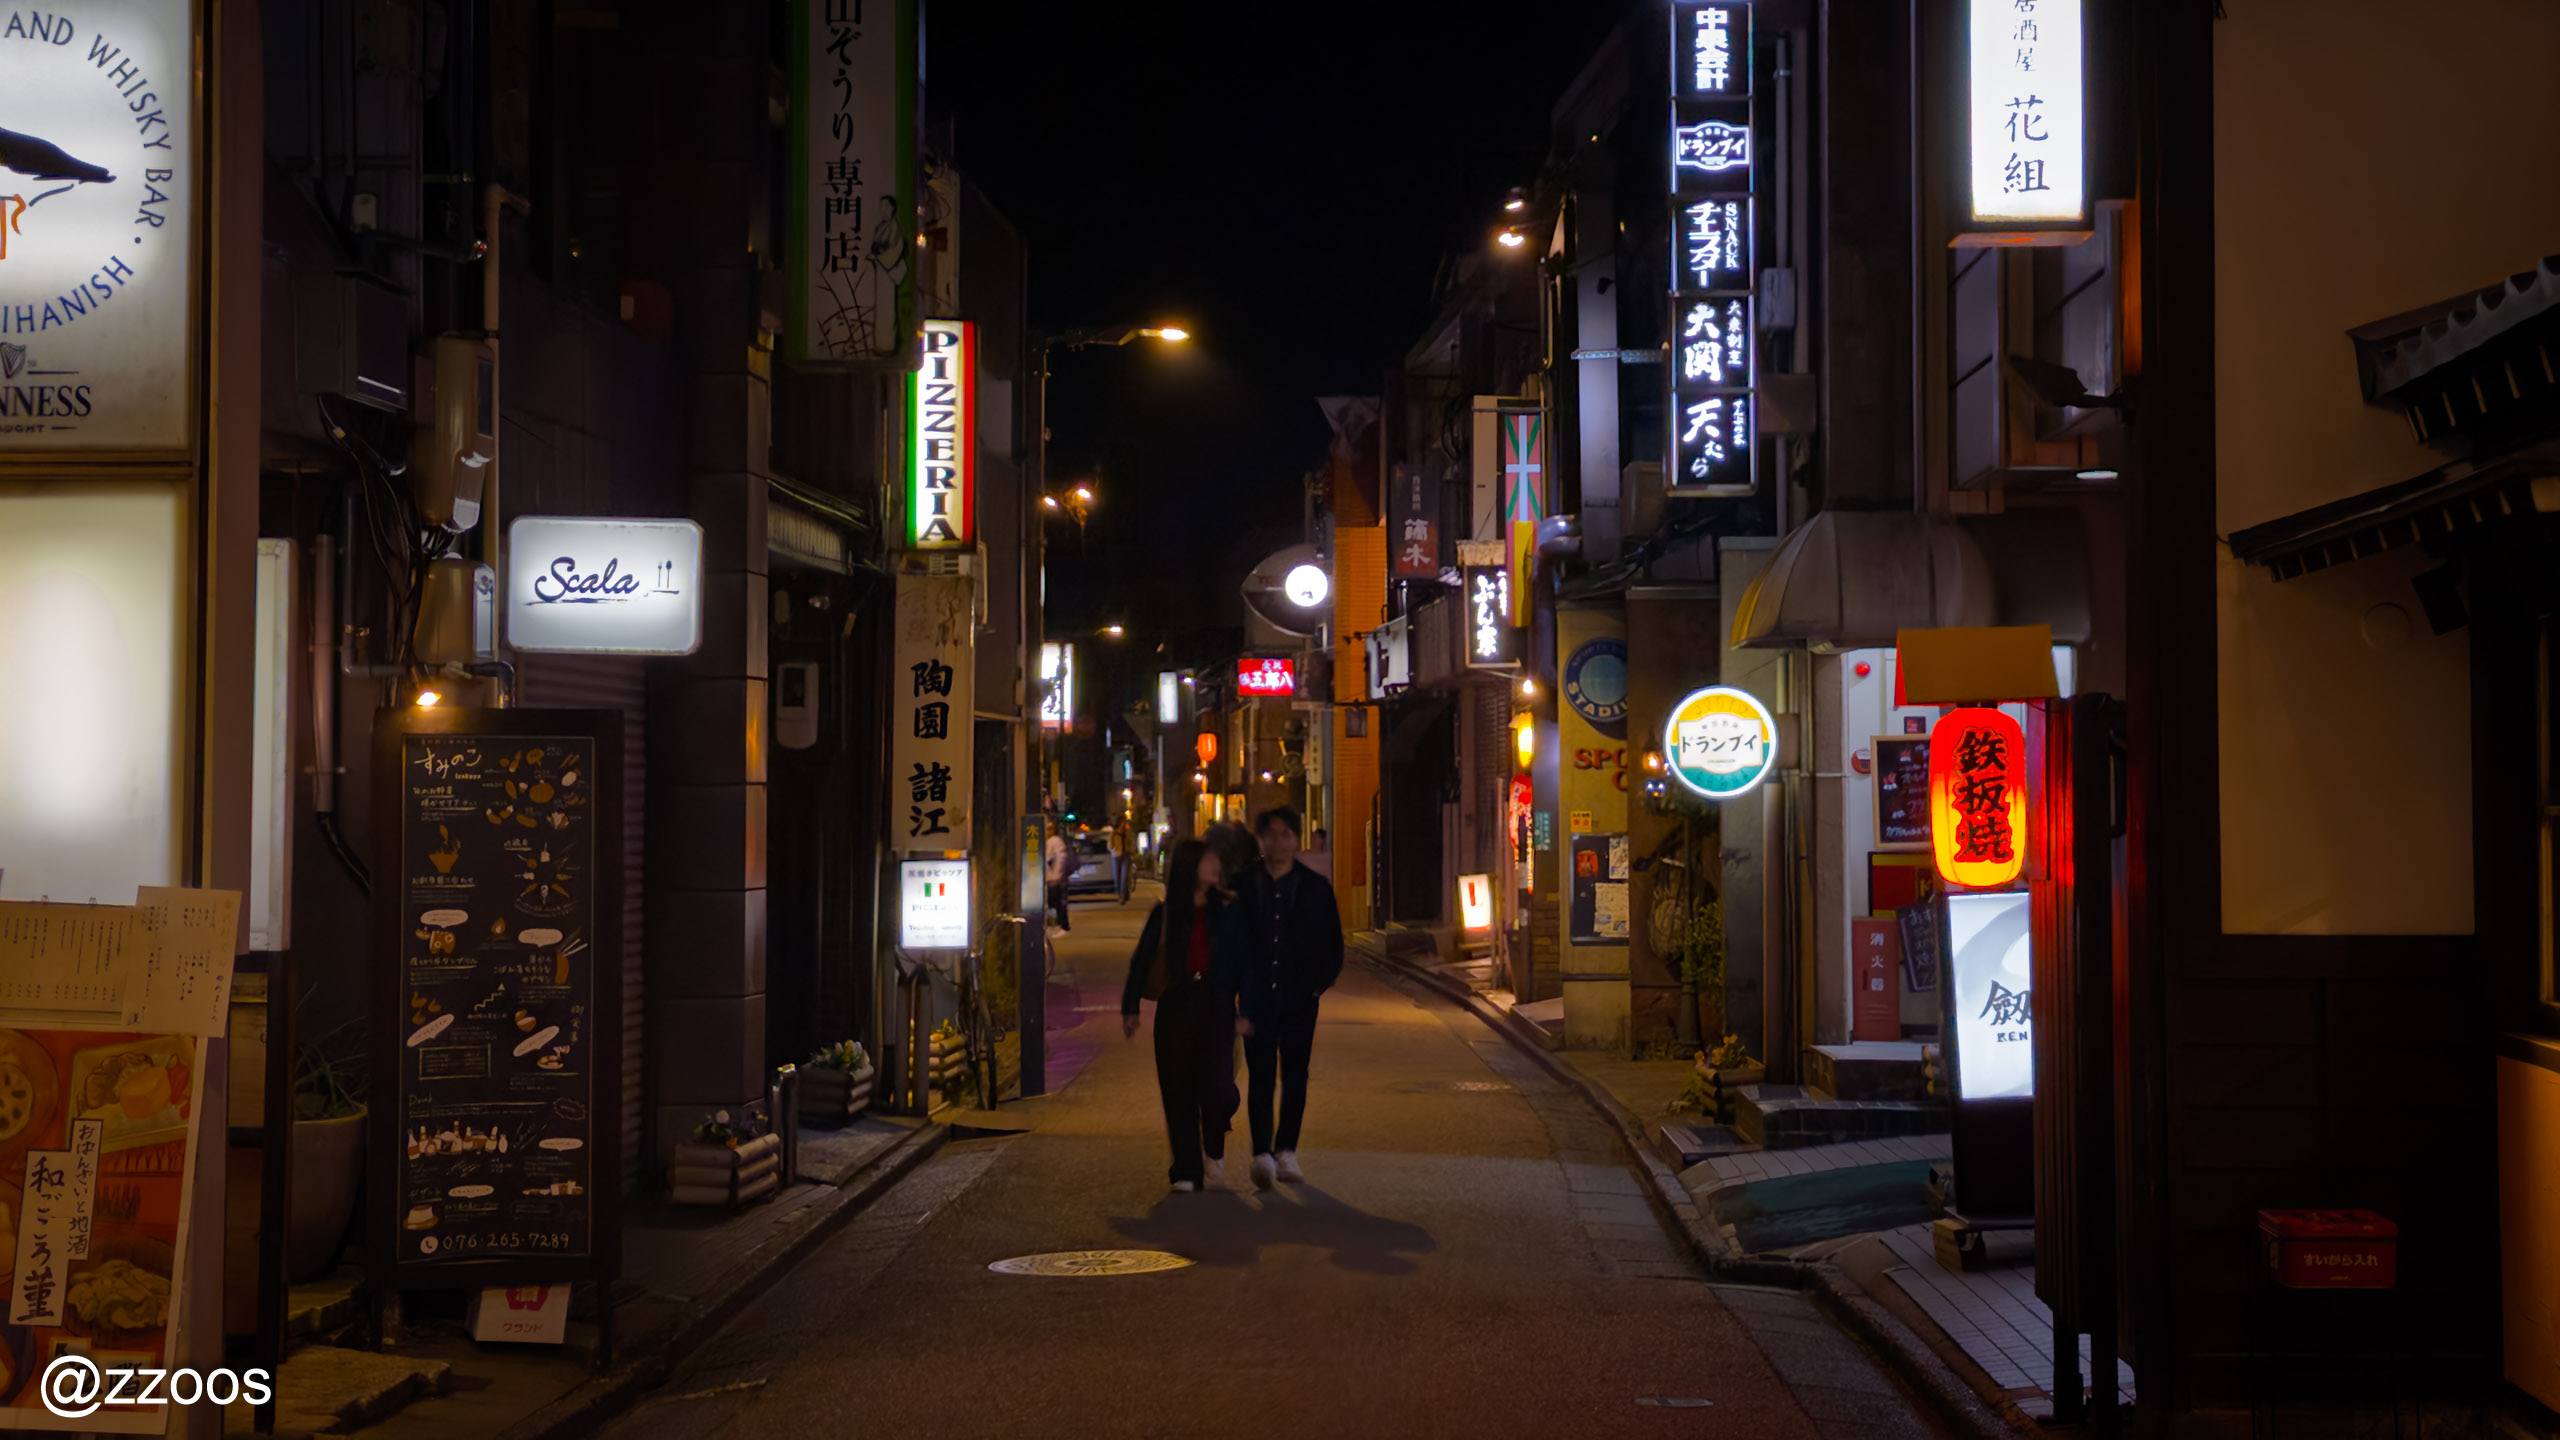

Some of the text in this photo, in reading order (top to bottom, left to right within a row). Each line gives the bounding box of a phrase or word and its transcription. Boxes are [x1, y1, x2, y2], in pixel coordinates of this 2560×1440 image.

[4, 11, 173, 228] AND WHISKY BAR
[2003, 94, 2050, 193] 花組
[1725, 203, 1737, 268] SNACK
[1684, 304, 1721, 382] 大関
[924, 330, 960, 542] PIZZERIA
[534, 556, 639, 602] Scala
[910, 659, 954, 740] 陶園
[907, 761, 953, 838] 諸江
[1955, 731, 2009, 860] 鉄板焼
